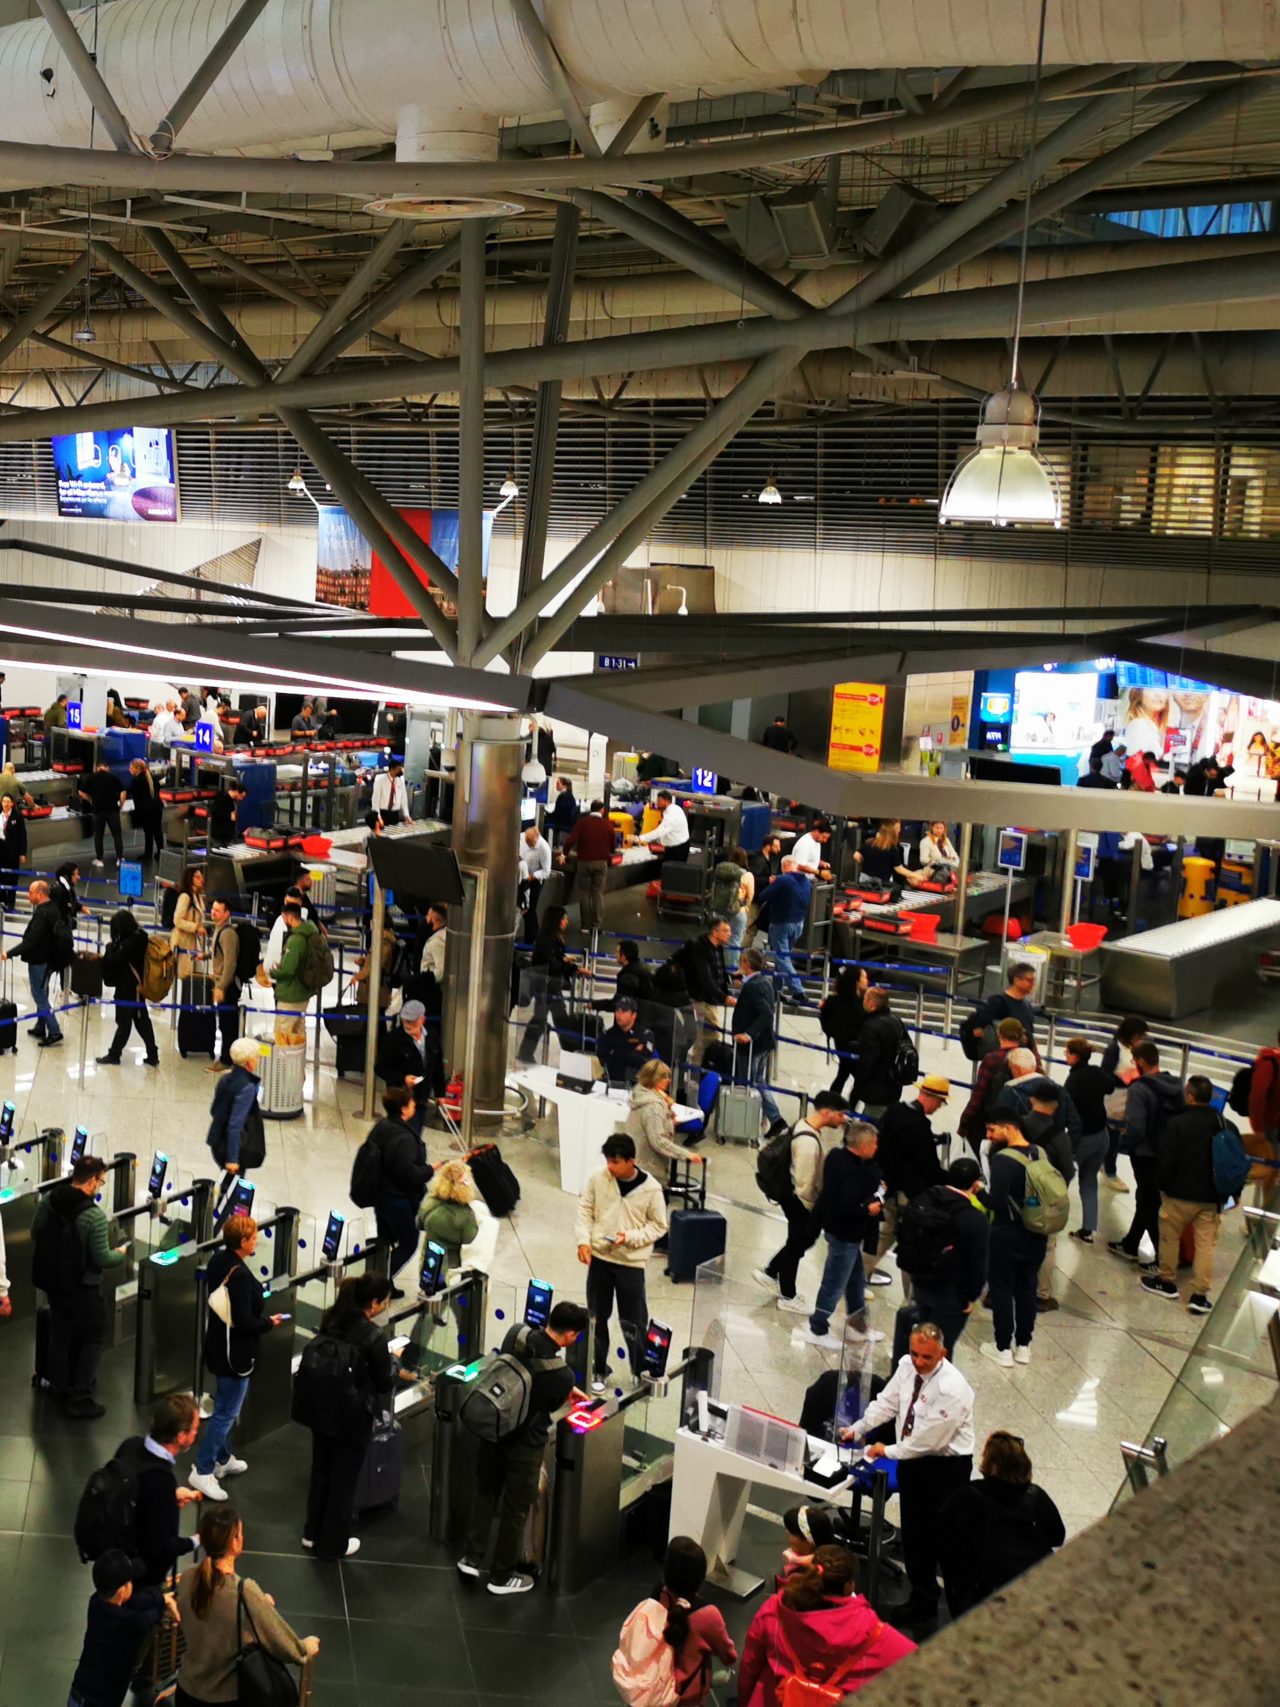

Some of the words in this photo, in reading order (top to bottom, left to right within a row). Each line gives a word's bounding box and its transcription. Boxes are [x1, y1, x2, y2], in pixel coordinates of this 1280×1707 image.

[604, 657, 610, 667] B
[612, 658, 626, 669] 1-31
[69, 708, 80, 723] 15
[197, 727, 211, 746] 14
[985, 731, 1002, 741] ATM
[696, 768, 713, 787] 12
